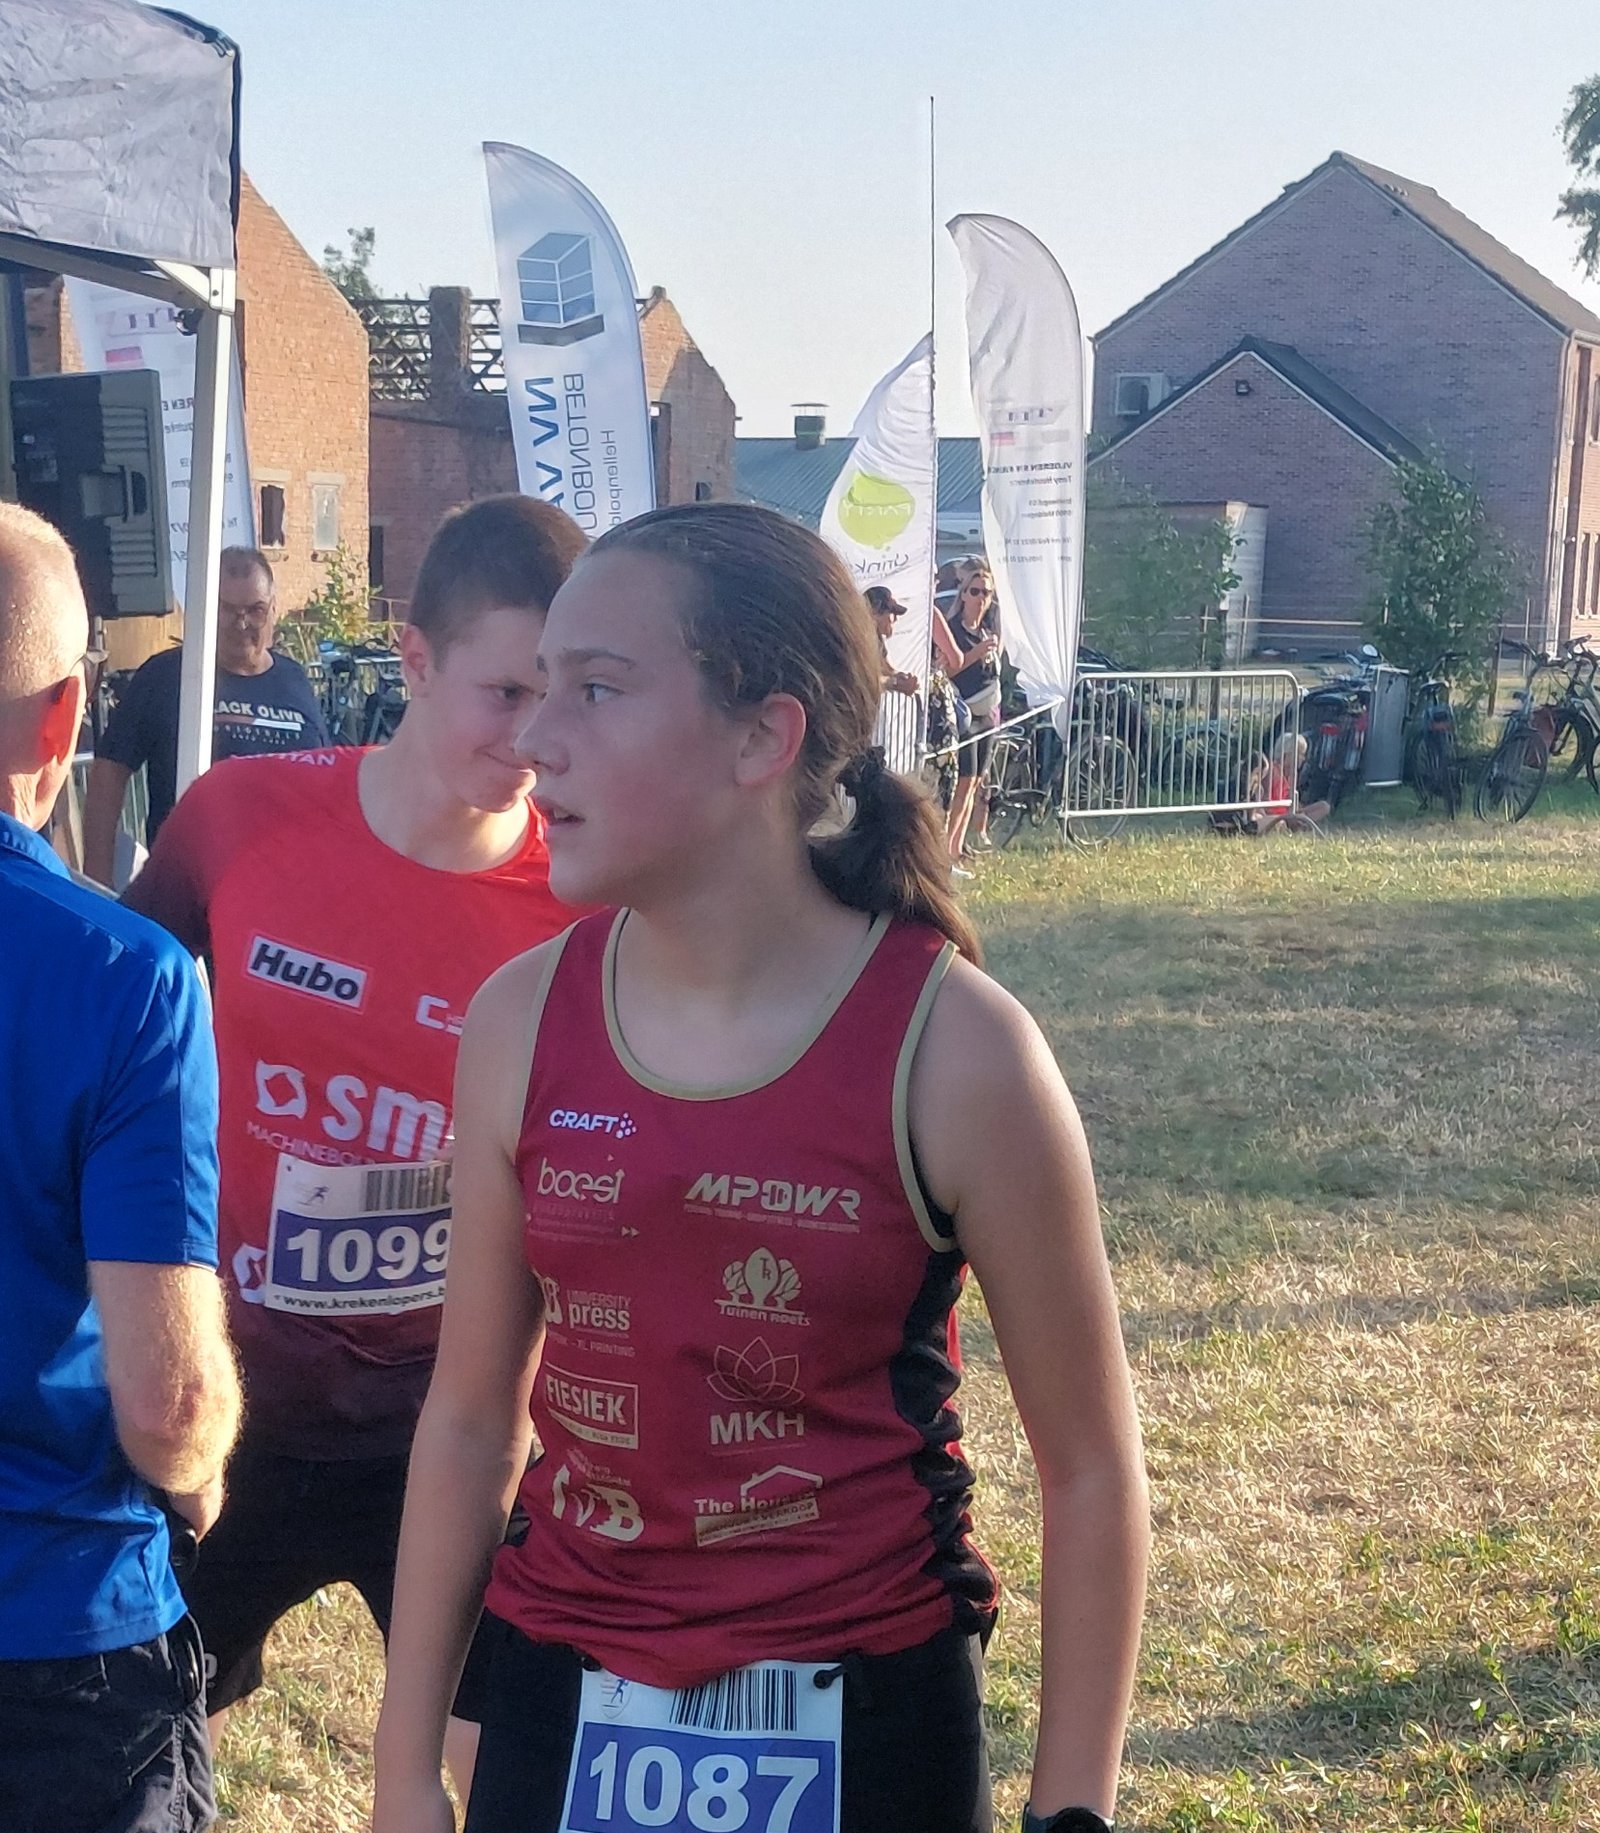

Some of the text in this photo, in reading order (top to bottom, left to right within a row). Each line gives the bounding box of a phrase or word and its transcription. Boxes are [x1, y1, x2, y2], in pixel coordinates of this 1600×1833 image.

[251, 943, 359, 1001] Hubo
[322, 1074, 456, 1160] sm
[549, 1109, 619, 1134] CRAFT
[246, 1120, 384, 1167] MACHINEBO
[287, 1218, 452, 1283] 1099
[283, 1286, 445, 1310] www.krekenlopers.b
[568, 1303, 631, 1332] press
[710, 1410, 805, 1445] MKH
[694, 1498, 735, 1514] The
